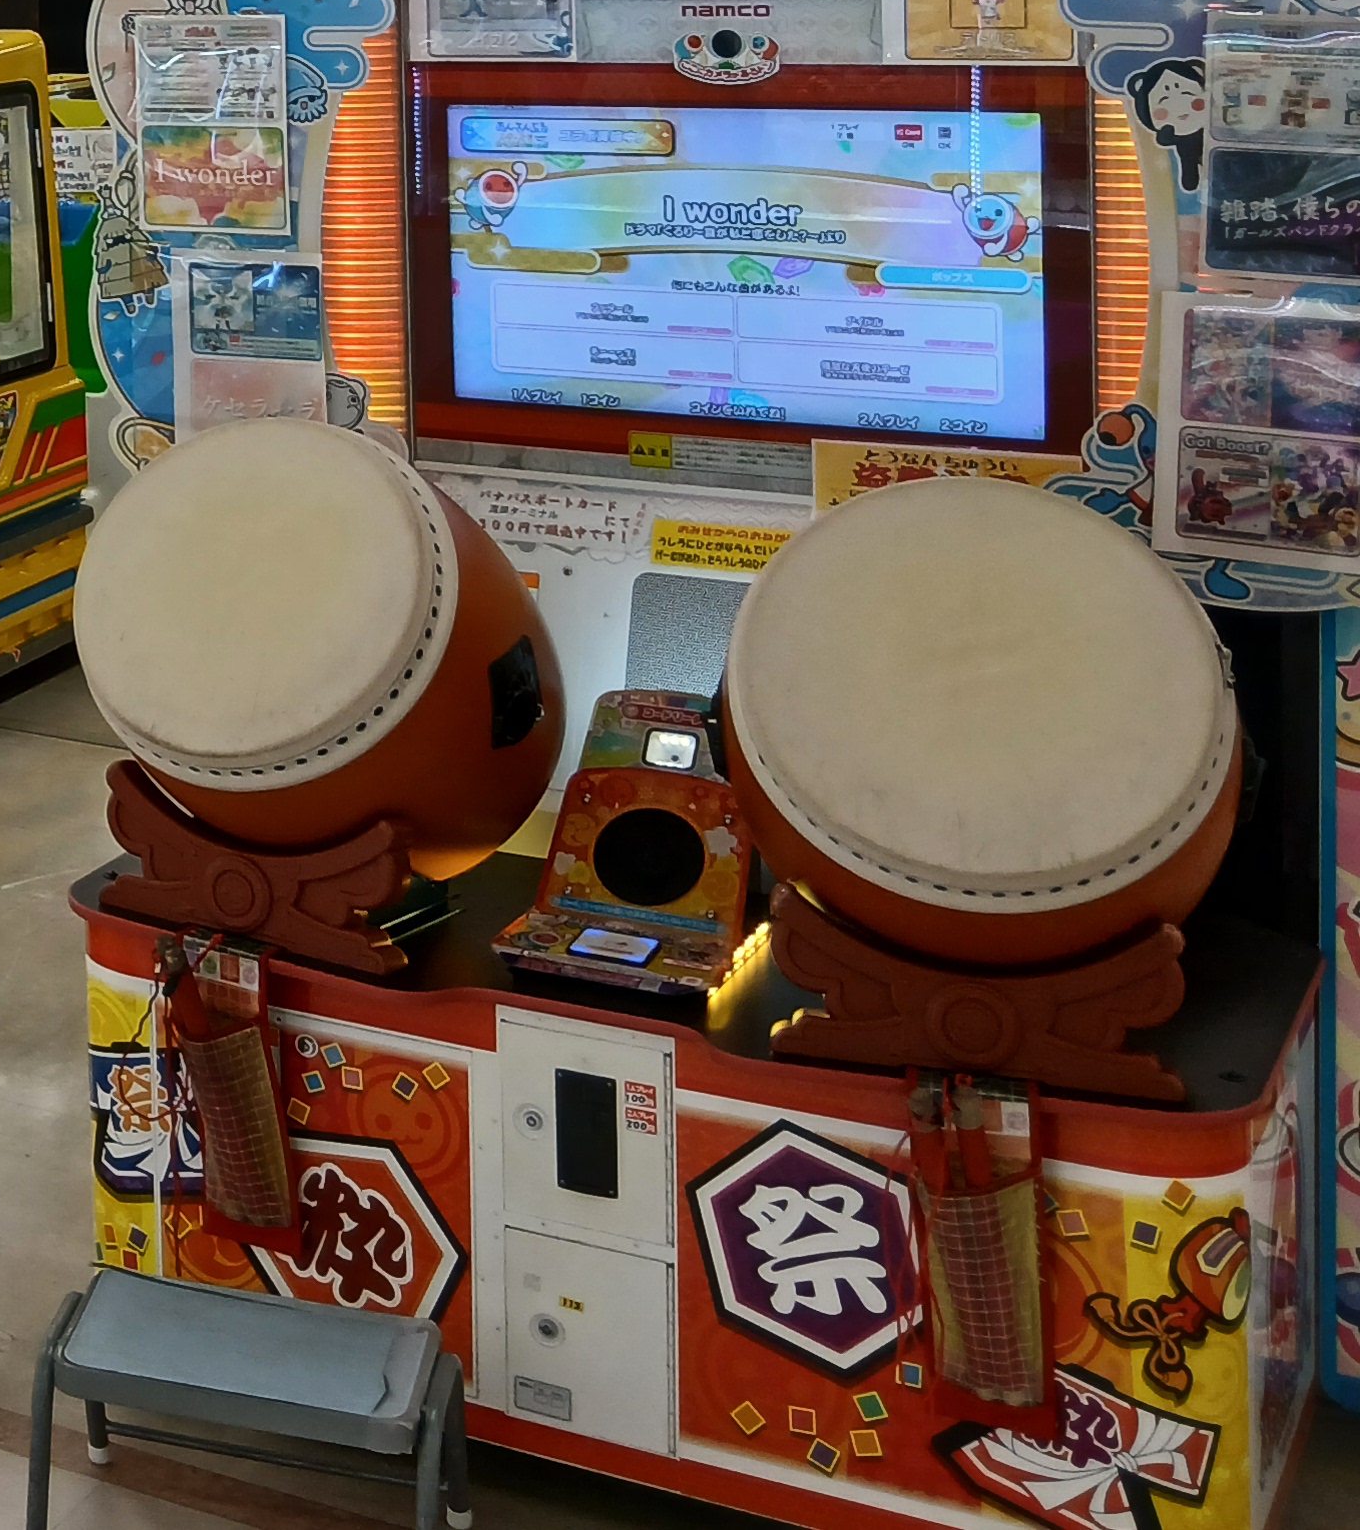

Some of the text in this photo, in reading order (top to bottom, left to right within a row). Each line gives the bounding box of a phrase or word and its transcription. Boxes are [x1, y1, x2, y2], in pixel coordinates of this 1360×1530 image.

[681, 4, 771, 18] namco
[176, 158, 278, 187] wonder
[682, 196, 803, 228] wonder
[857, 412, 988, 434] 2人プレイ 2コイン
[1183, 432, 1271, 456] Got Boost?
[739, 1182, 888, 1317] 祭
